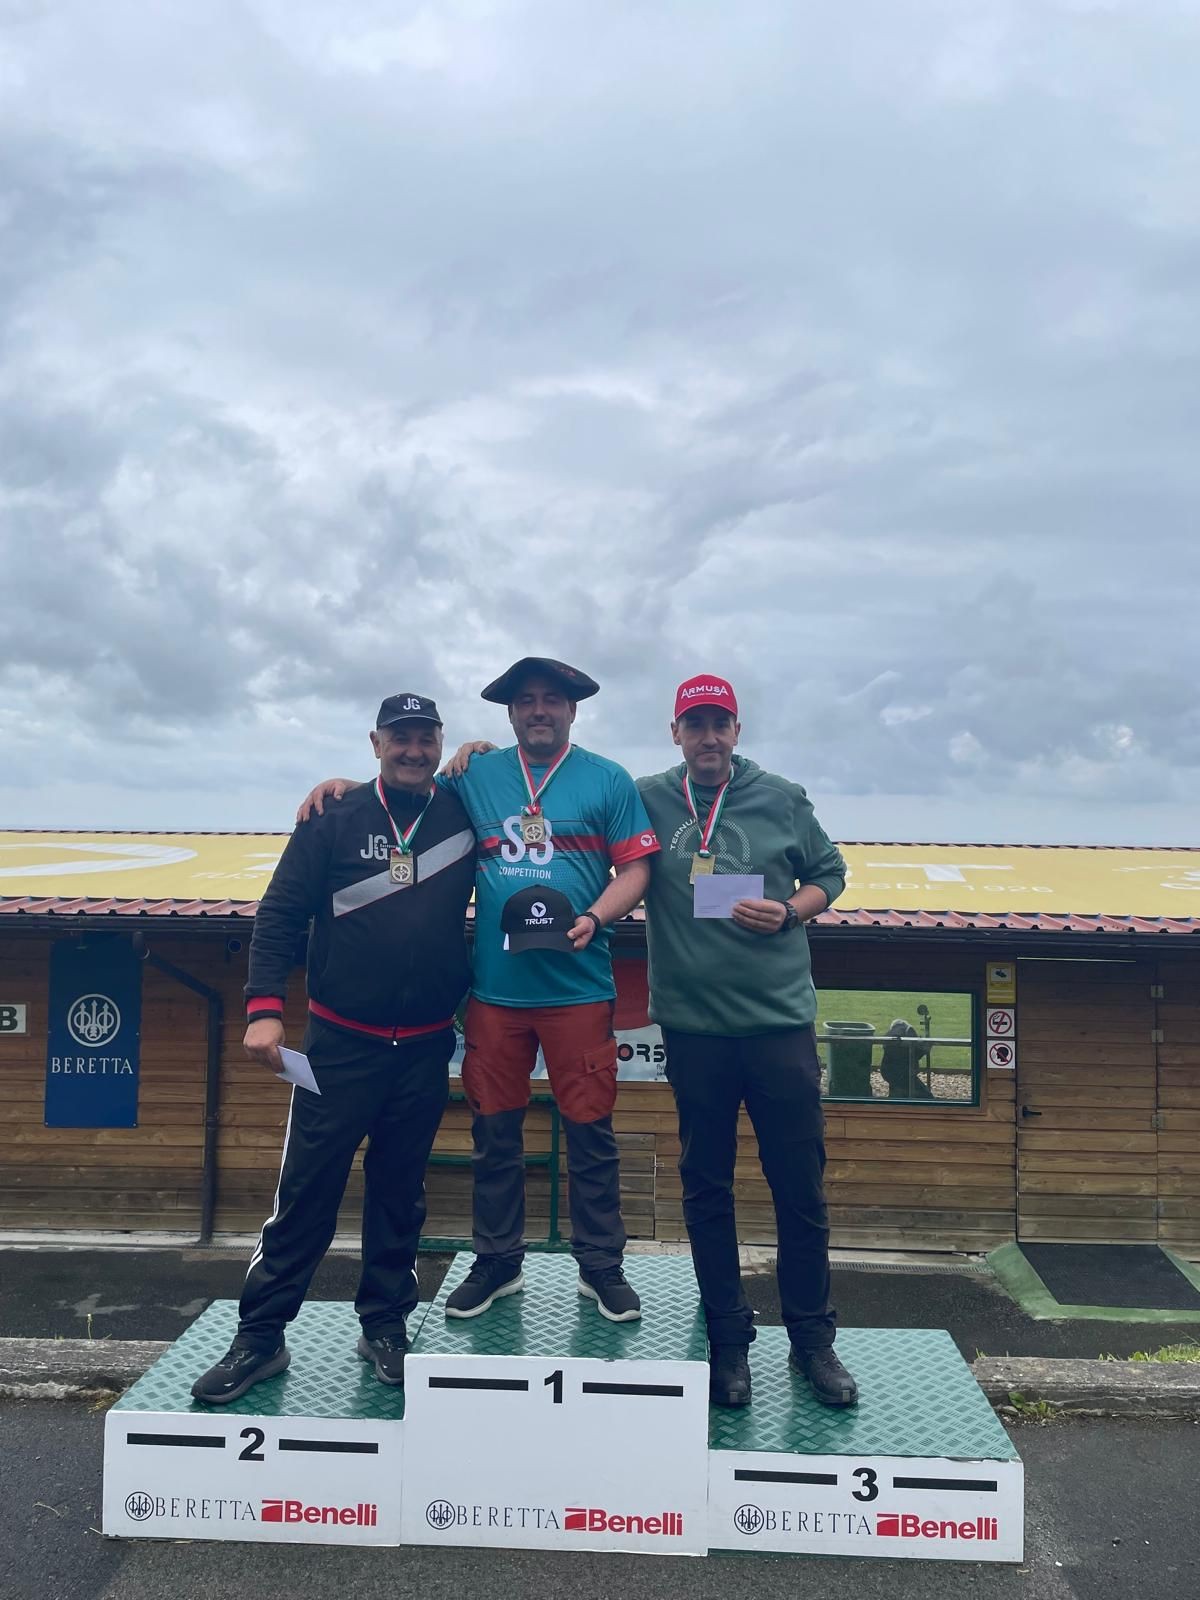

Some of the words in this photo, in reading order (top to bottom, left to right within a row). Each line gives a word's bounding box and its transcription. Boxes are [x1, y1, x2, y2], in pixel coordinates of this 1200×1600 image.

[403, 697, 420, 710] JG
[681, 685, 729, 700] ARMUSA
[360, 834, 388, 861] JG
[498, 866, 552, 880] COMPETITION
[846, 881, 944, 891] ESDE
[524, 917, 554, 925] TRUST
[51, 1057, 134, 1074] BERETTA
[543, 1370, 564, 1404] 1
[238, 1427, 265, 1461] 2
[852, 1467, 879, 1502] 3
[155, 1496, 257, 1521] BERETTA
[284, 1500, 377, 1527] Benelli
[456, 1504, 560, 1530] BERETTA
[588, 1508, 683, 1536] Benelli
[766, 1509, 872, 1535] BERETTA
[901, 1514, 998, 1540] Benelli
